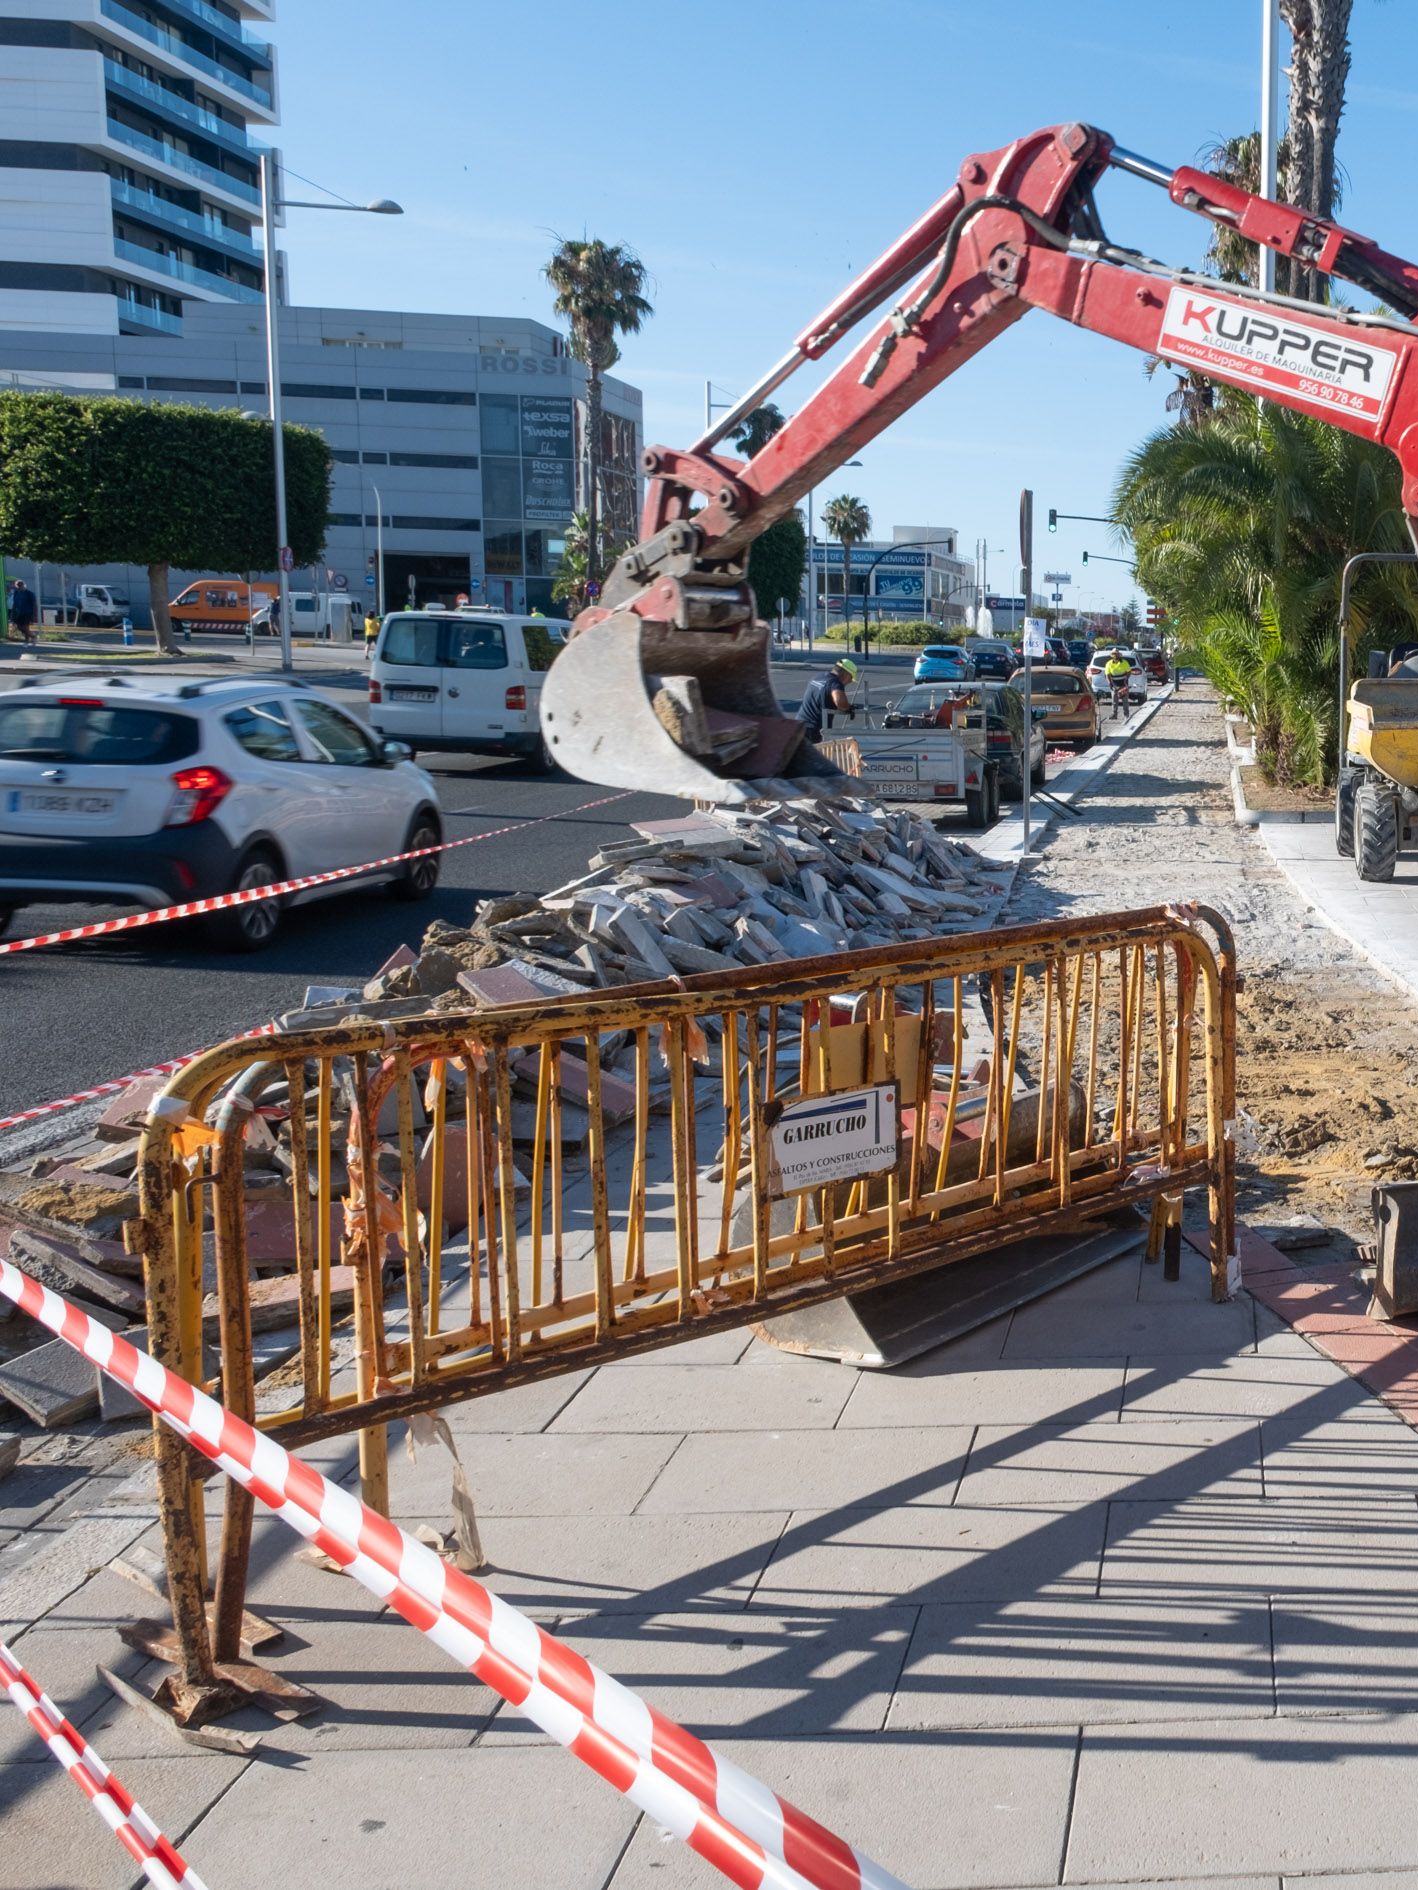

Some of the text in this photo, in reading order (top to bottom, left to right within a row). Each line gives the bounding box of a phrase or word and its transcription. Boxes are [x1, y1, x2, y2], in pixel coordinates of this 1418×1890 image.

[1182, 300, 1374, 383] KUPPER
[480, 355, 568, 375] ROSSI
[1176, 341, 1265, 377] www.kupper.es
[1201, 335, 1342, 386] ALQUILER DE MAQUINARIA
[1298, 379, 1364, 409] 956 90 78 46
[523, 411, 570, 422] texsa
[533, 427, 570, 438] weber
[532, 460, 564, 470] Roca
[830, 553, 841, 561] DE
[882, 783, 905, 793] 6812
[783, 1114, 867, 1145] GARRUCHO
[809, 1160, 816, 1169] Y
[816, 1144, 896, 1168] CONSTRUCCIONES
